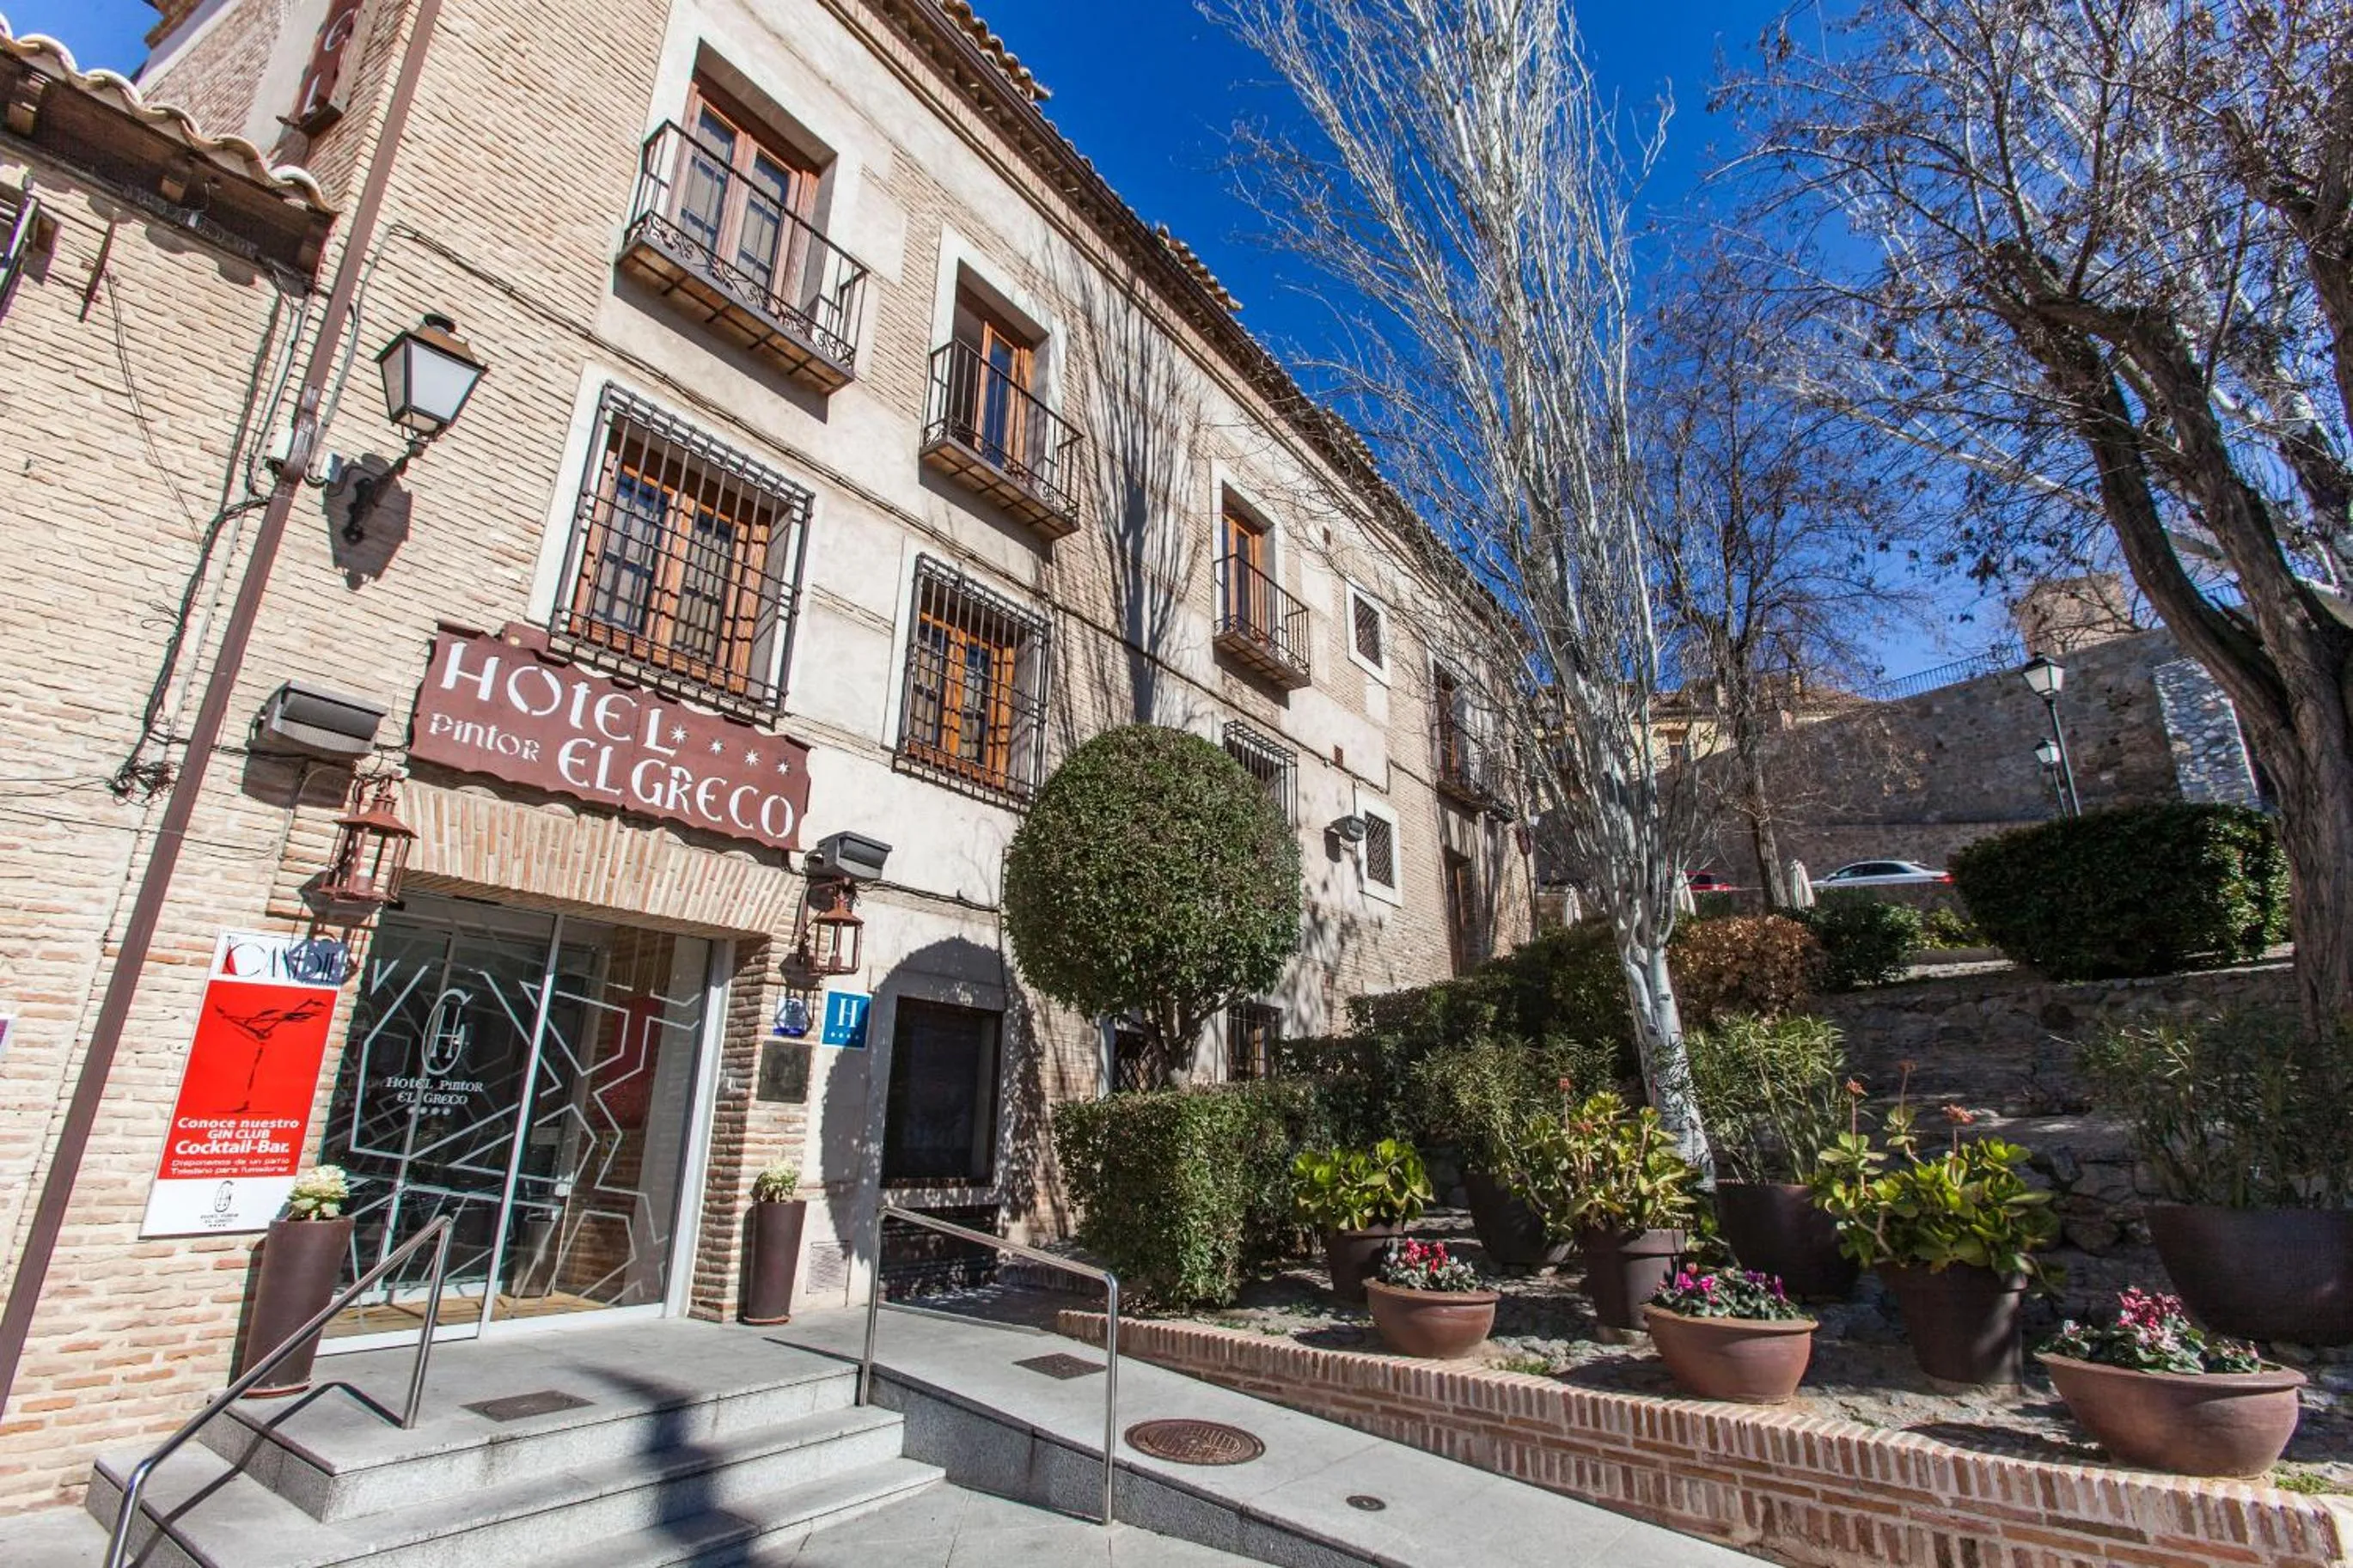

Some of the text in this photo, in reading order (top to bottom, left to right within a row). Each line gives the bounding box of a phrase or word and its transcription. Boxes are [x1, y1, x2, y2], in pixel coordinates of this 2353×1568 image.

[440, 641, 677, 757] HOTEL
[558, 737, 623, 796] EL
[631, 758, 795, 839] GRECO
[837, 998, 859, 1028] H
[385, 1077, 433, 1089] HOTEL
[397, 1091, 468, 1105] EL GRECO
[177, 1117, 300, 1129] Conoce nuestro
[207, 1128, 272, 1139] GIN CLUB
